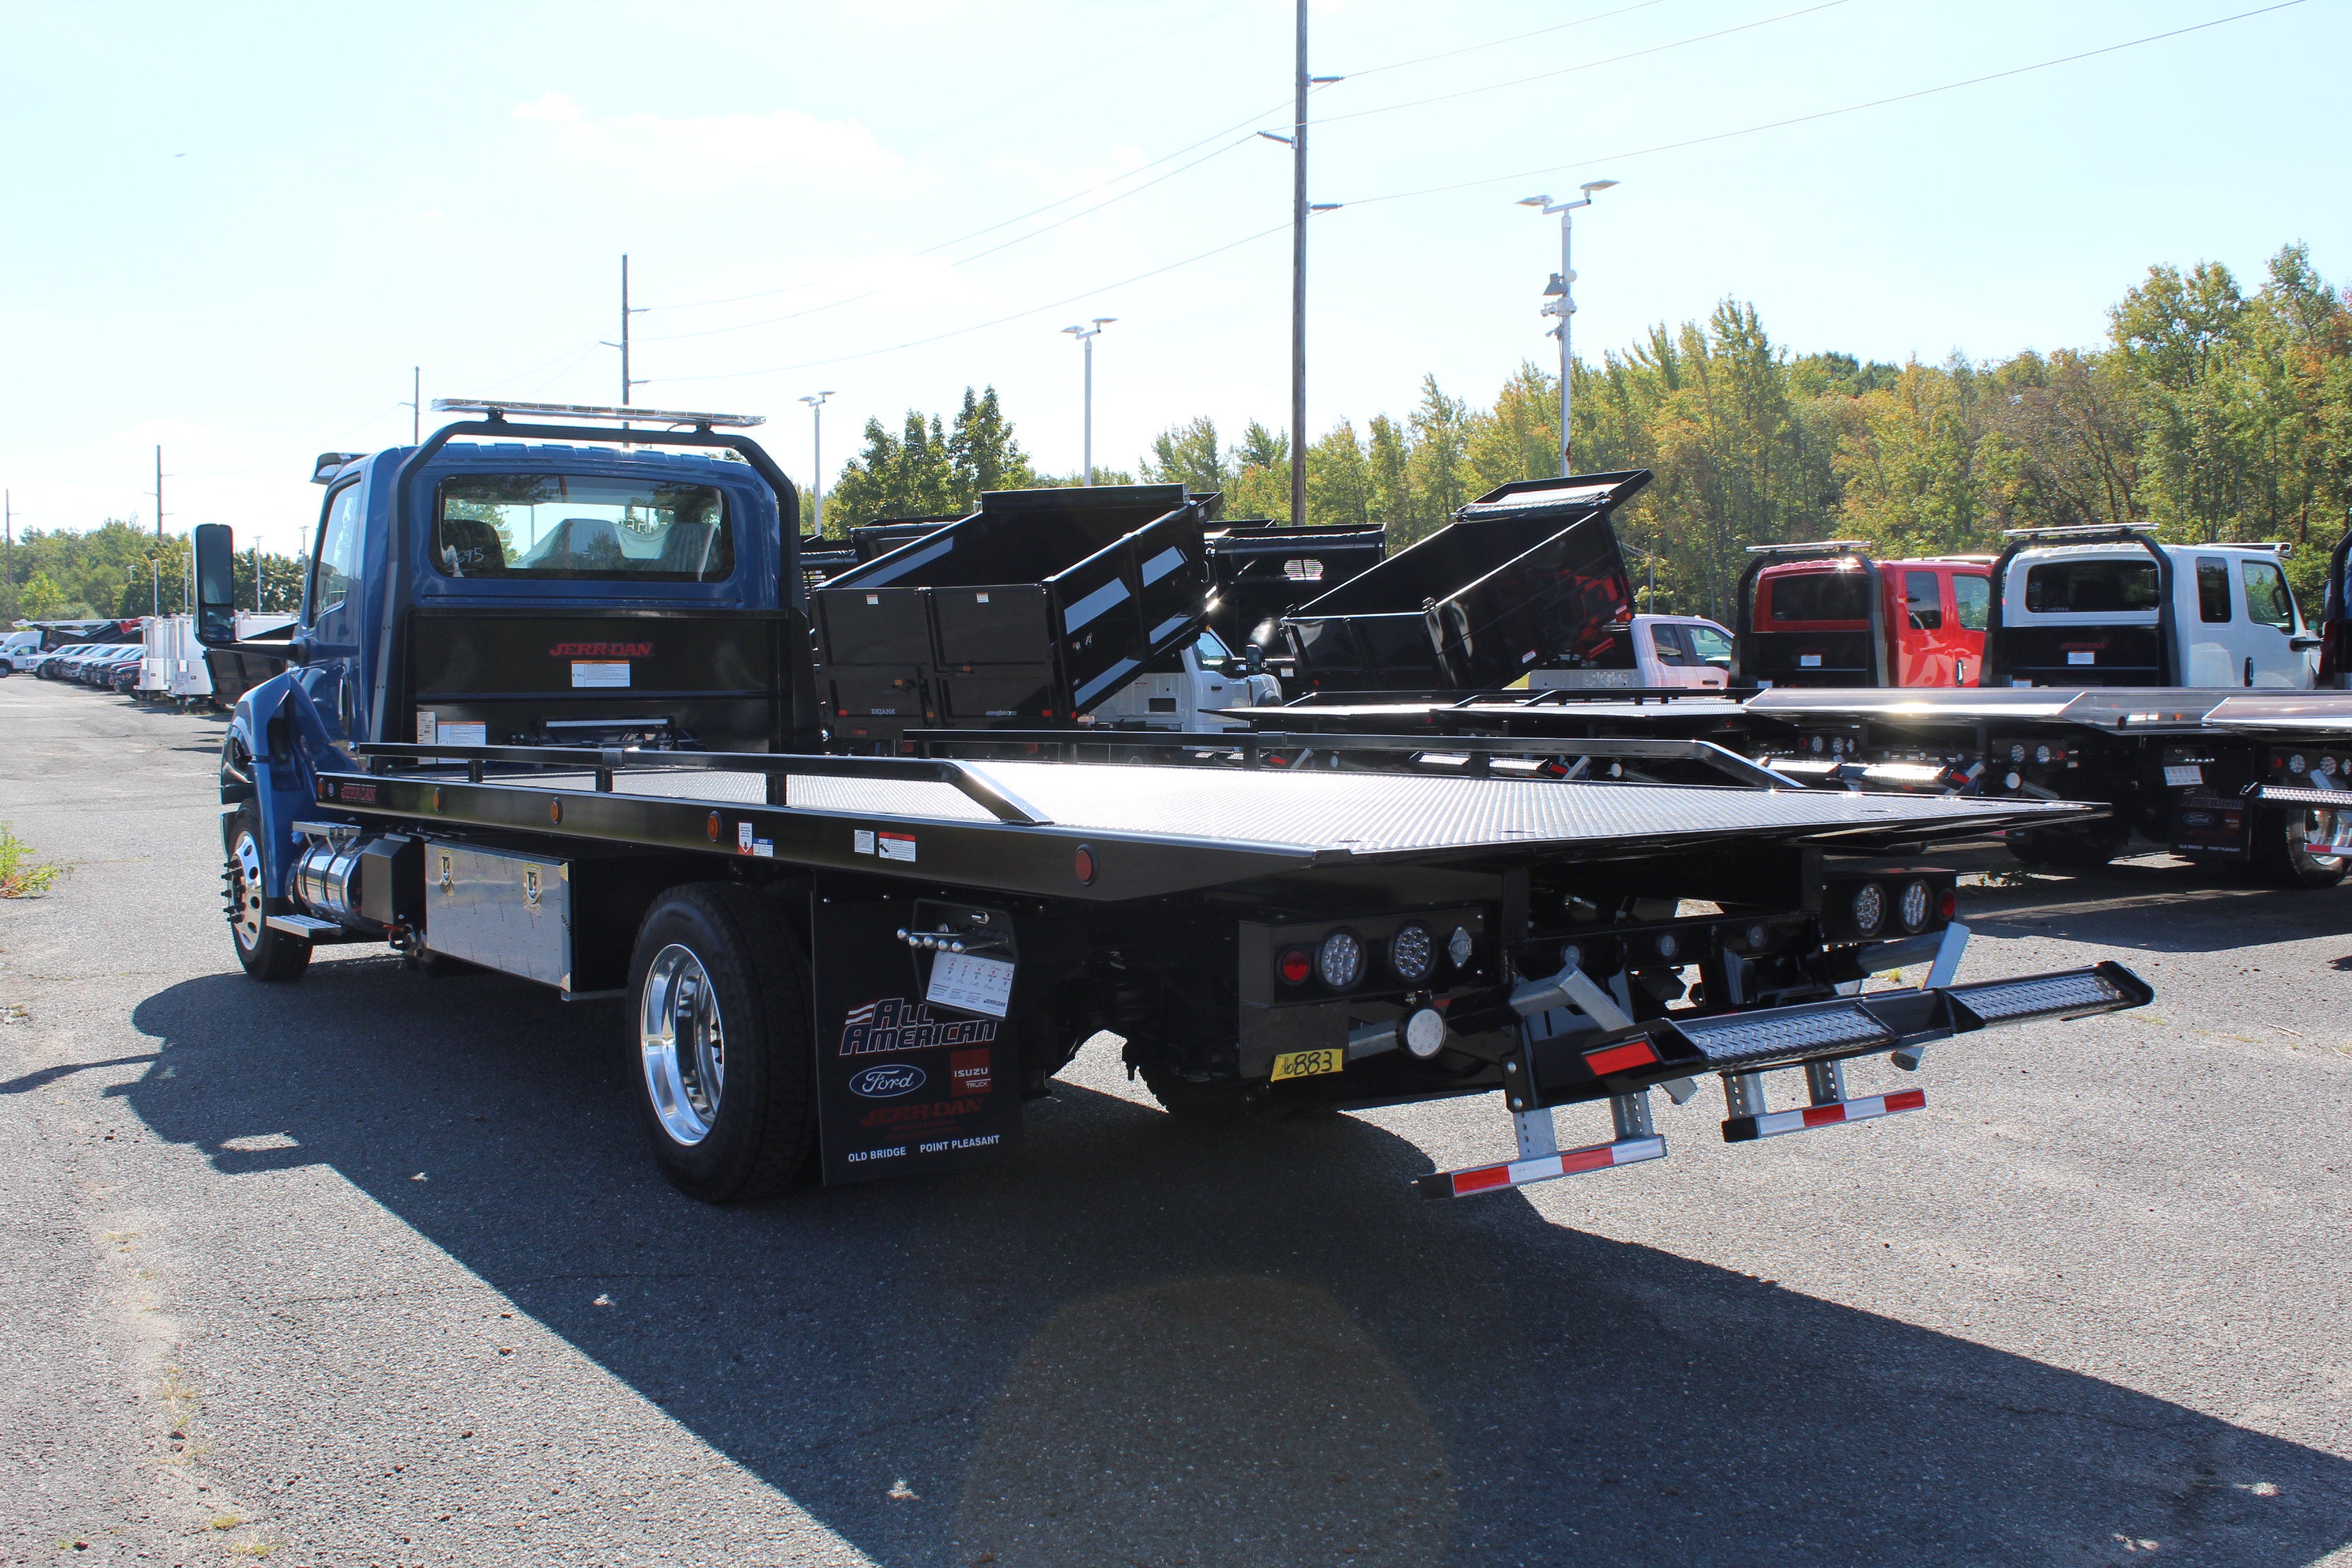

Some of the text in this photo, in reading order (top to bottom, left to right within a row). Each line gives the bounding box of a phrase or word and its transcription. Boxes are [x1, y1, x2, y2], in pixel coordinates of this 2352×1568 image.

[549, 643, 653, 656] JERR-DAN
[2187, 814, 2209, 823] Ford
[872, 998, 934, 1030] ALL
[840, 1019, 997, 1056] AMERICAN
[862, 1069, 915, 1093] Ford
[954, 1067, 988, 1077] ISUZU
[860, 1097, 984, 1128] JERR-DAN
[848, 1134, 1000, 1162] OLD BRIDGE POINT PLEASANT
